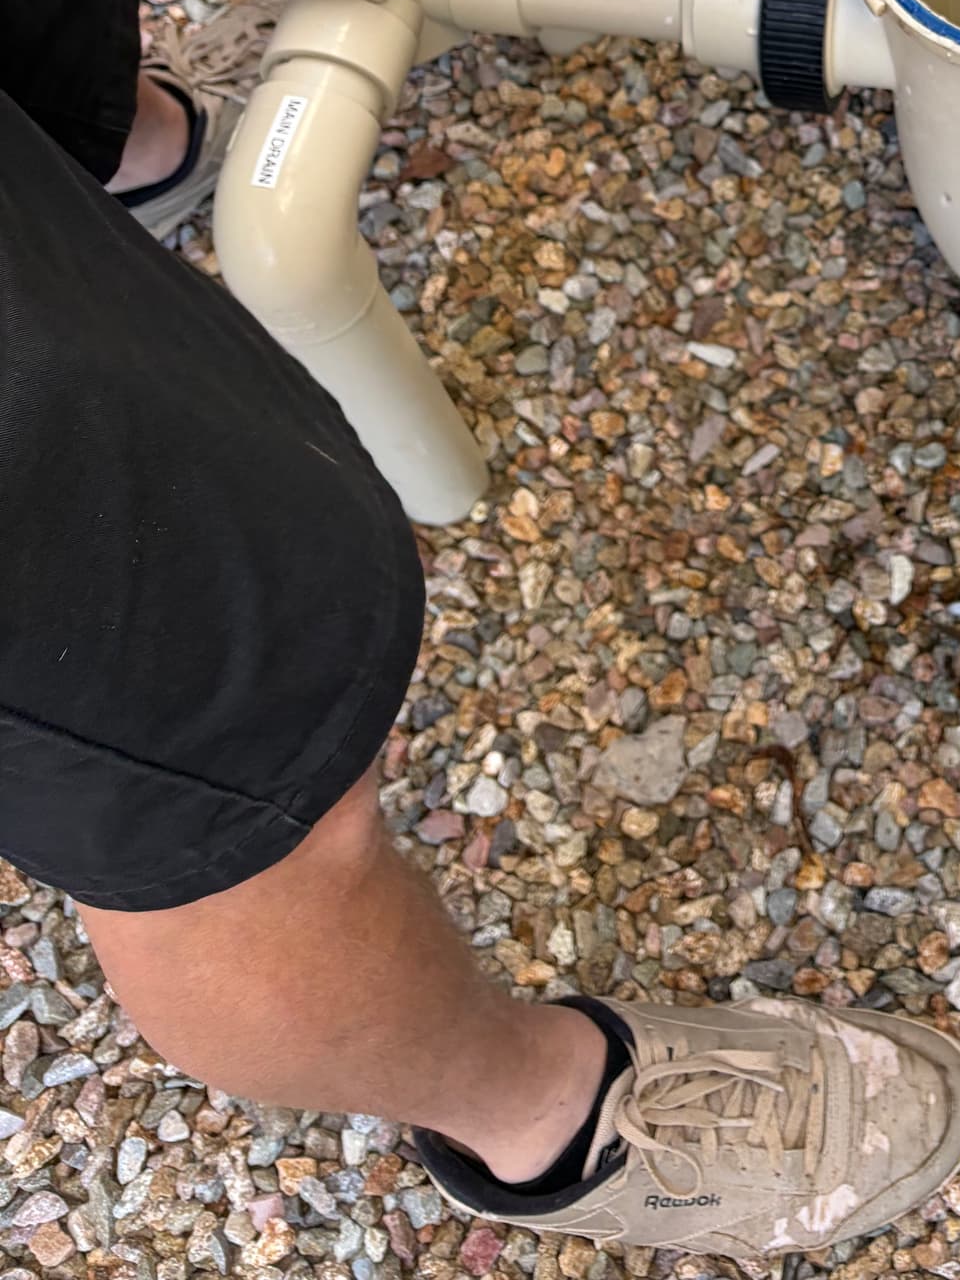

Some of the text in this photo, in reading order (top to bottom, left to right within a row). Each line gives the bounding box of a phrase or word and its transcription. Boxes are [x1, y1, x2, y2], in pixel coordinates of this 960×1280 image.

[258, 99, 301, 185] MAIN DRAIN
[644, 1193, 722, 1210] Reebok
